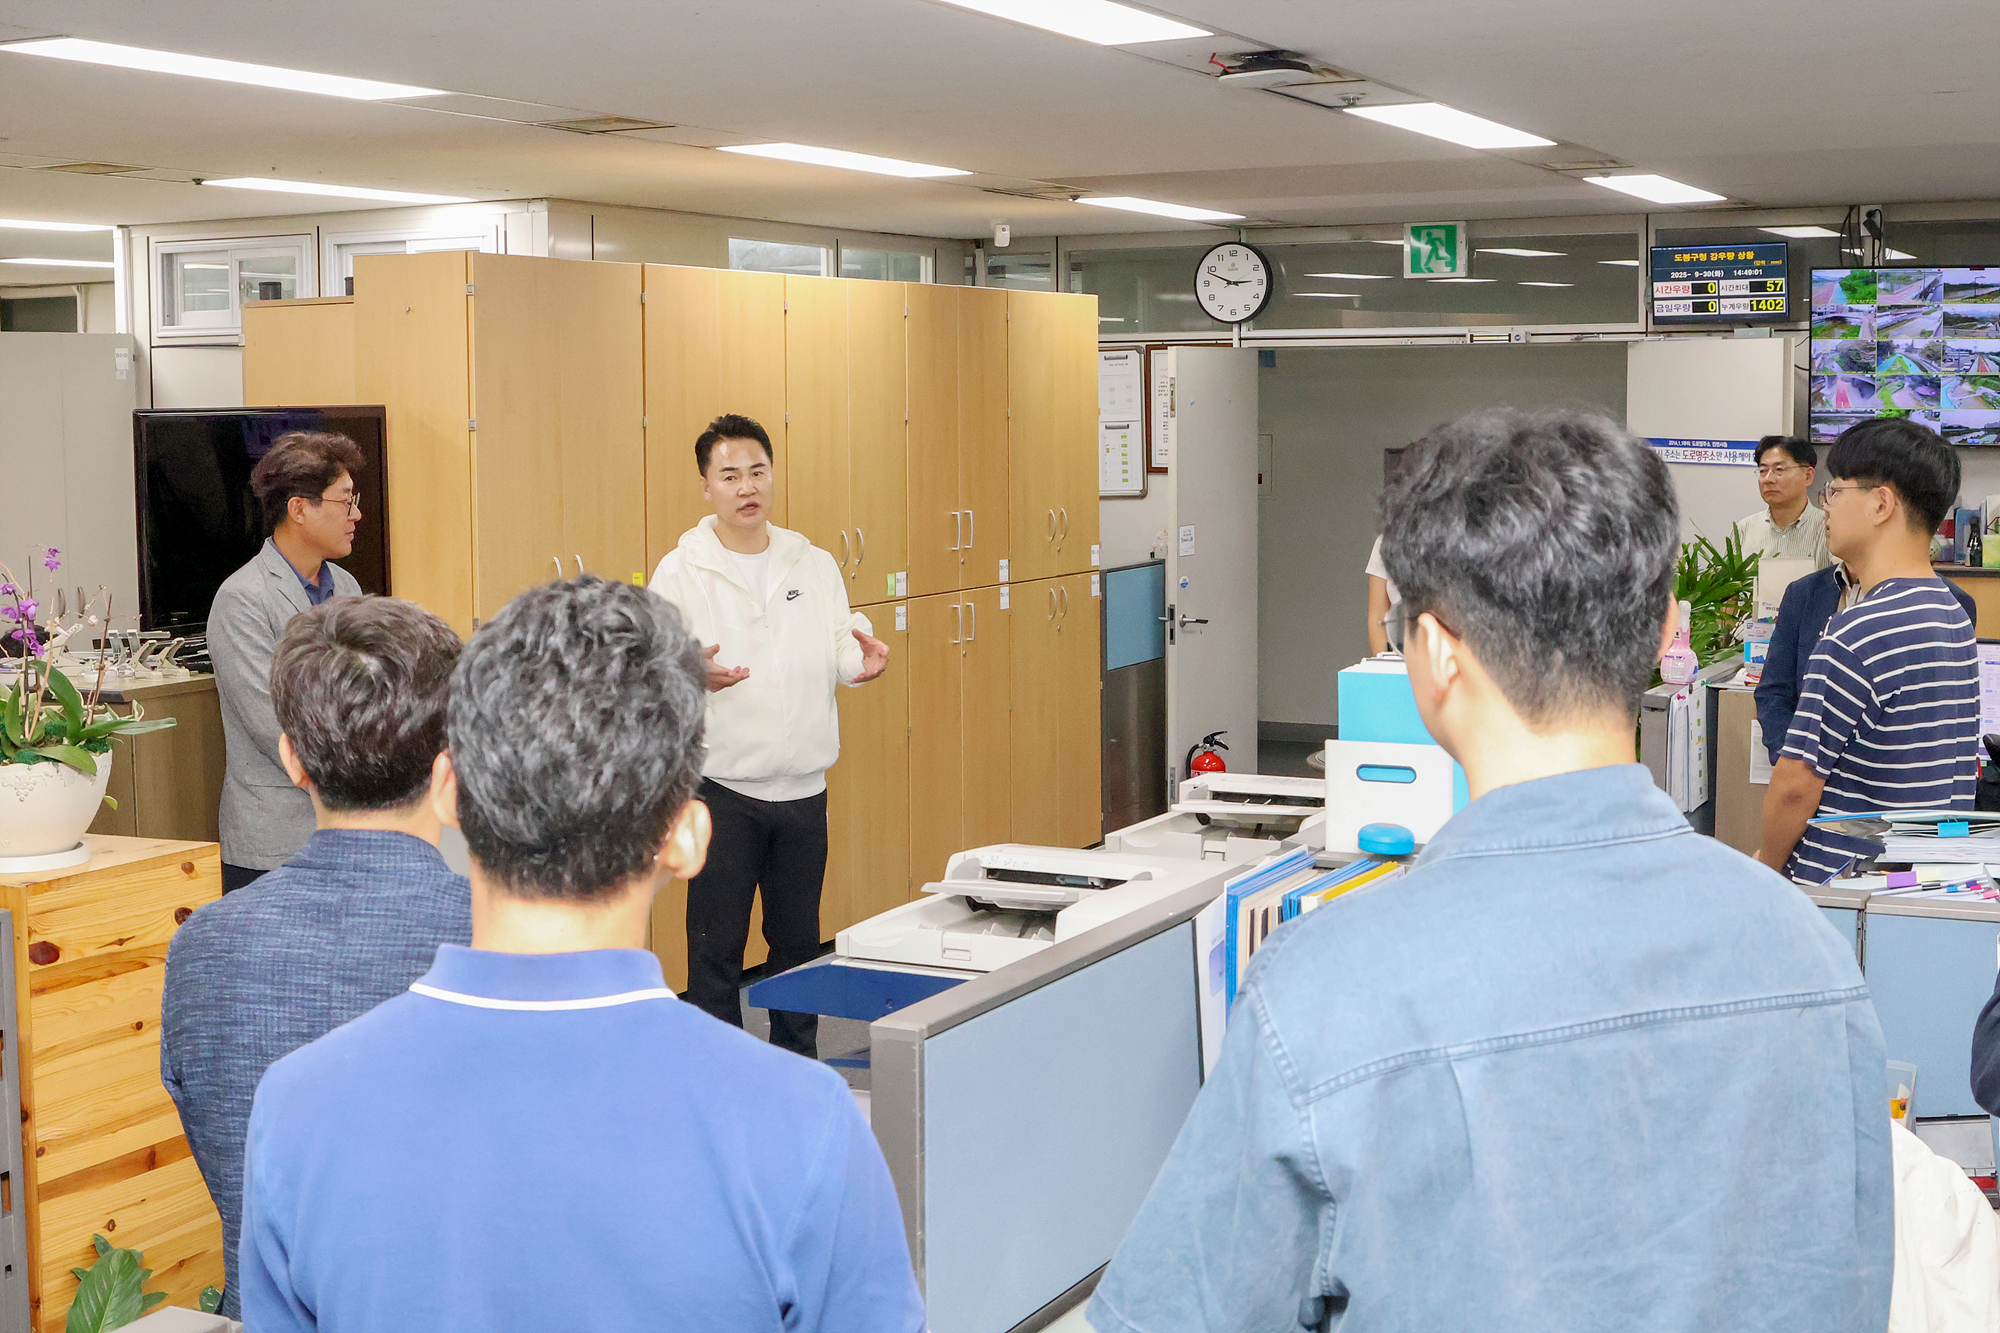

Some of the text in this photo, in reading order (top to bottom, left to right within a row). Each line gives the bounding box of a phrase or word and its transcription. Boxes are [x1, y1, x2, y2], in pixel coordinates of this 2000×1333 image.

[1674, 251, 1754, 262] 도봉구청 강우량 상황
[1655, 282, 1715, 294] 시간우량 0
[1721, 280, 1783, 292] 시간최대 57
[1656, 301, 1716, 313] 금일우량 0
[1722, 299, 1784, 311] 누계우량 1402
[1664, 450, 1680, 460] 주소는
